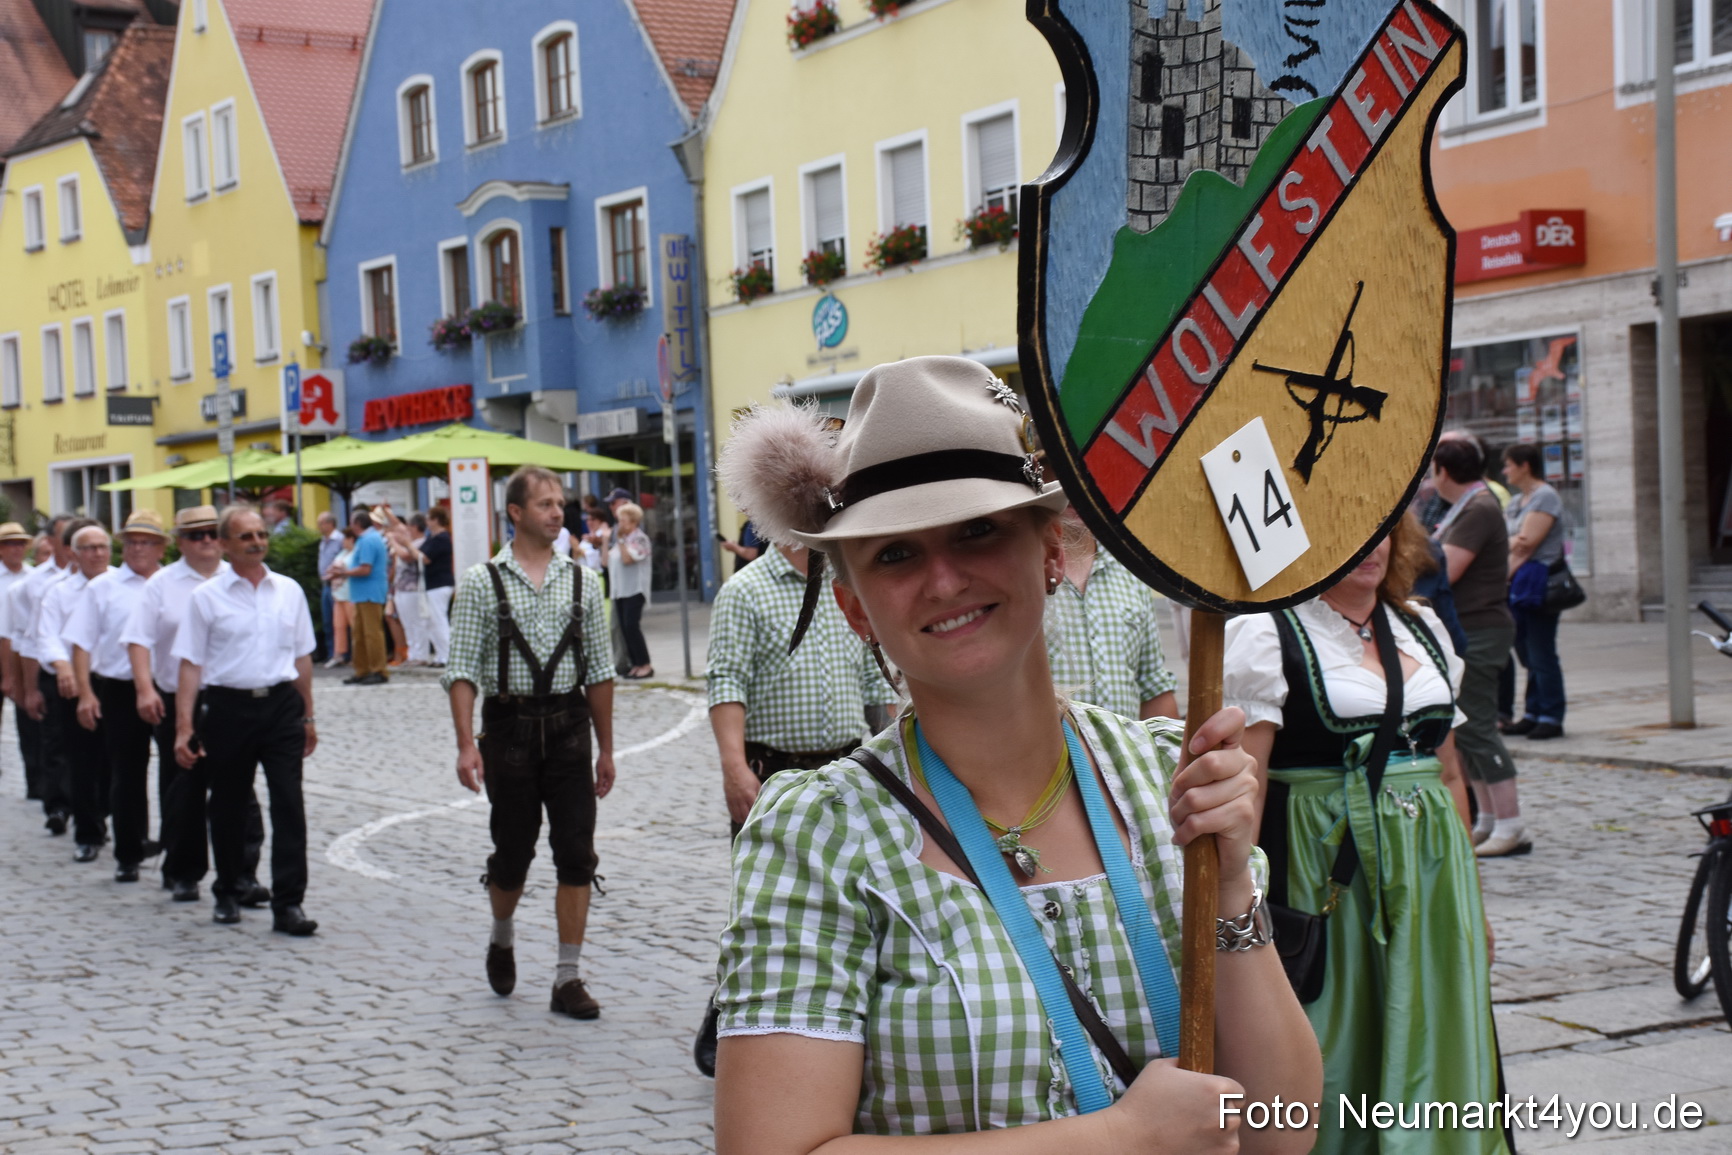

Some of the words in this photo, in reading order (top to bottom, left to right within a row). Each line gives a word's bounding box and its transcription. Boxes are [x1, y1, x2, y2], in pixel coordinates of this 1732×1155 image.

[1103, 4, 1440, 468] WOLFSTEIN
[1481, 230, 1521, 250] Deutsch
[1536, 224, 1576, 248] DER
[1482, 251, 1523, 271] Reisebü
[47, 279, 88, 313] HOTEL
[668, 263, 693, 369] WITTL
[215, 336, 227, 373] P
[286, 369, 298, 407] P
[362, 384, 475, 433] APOTHEKE
[54, 432, 107, 455] Restaurant
[1227, 468, 1293, 553] 14
